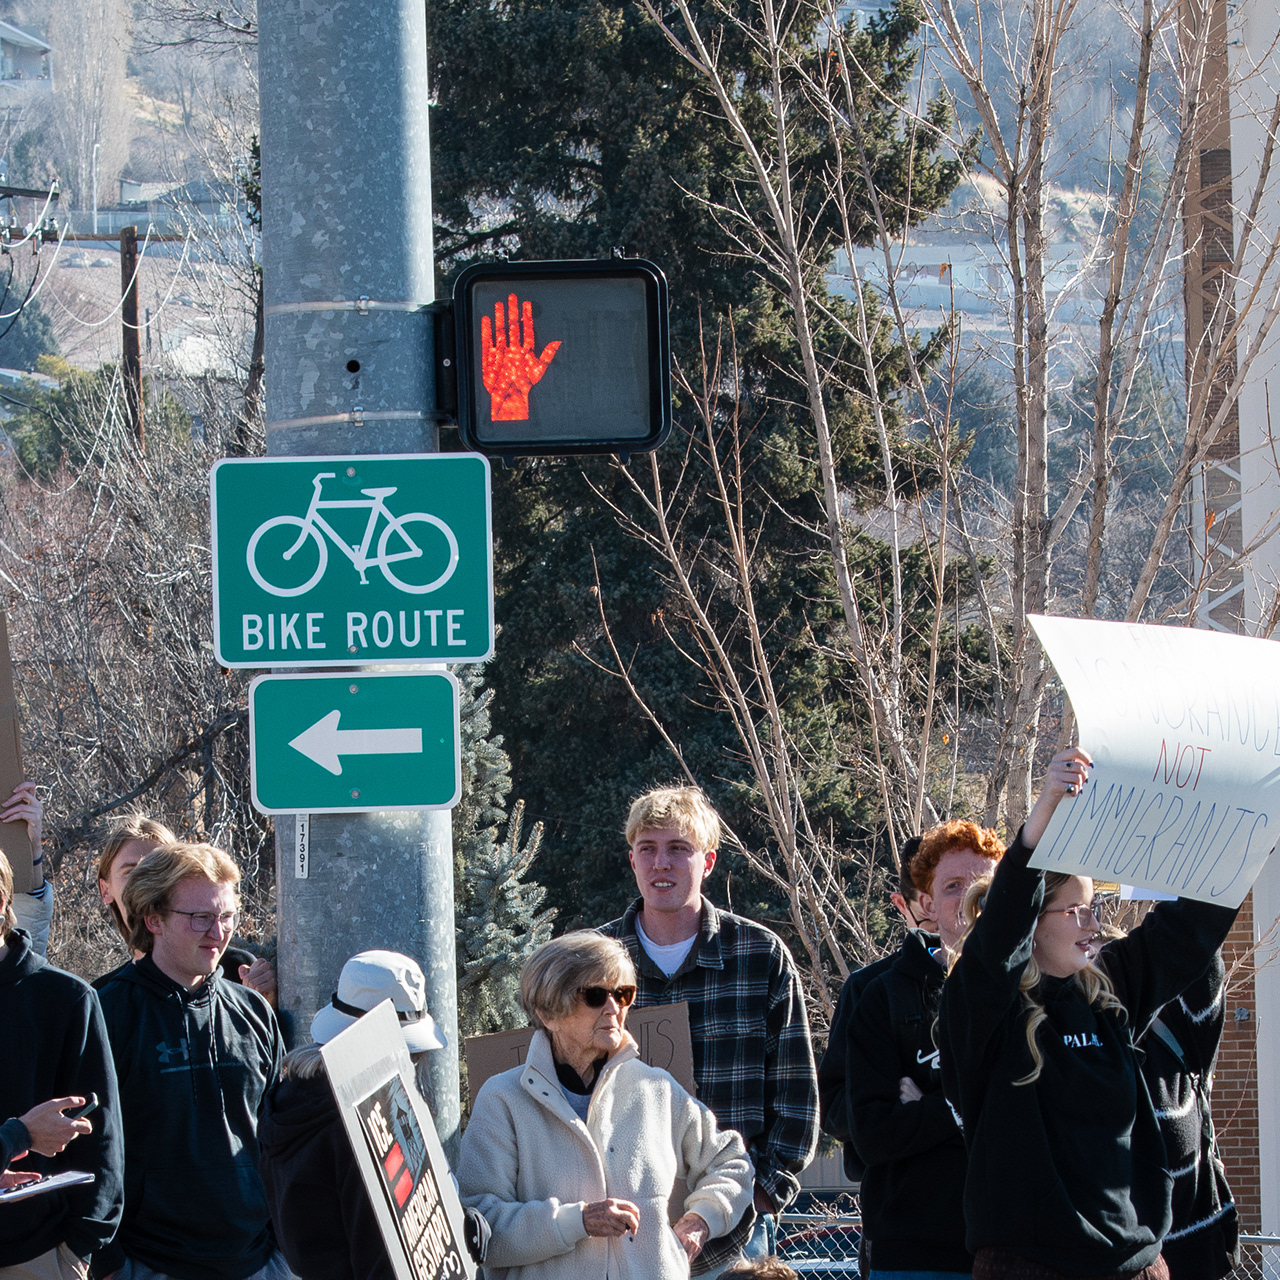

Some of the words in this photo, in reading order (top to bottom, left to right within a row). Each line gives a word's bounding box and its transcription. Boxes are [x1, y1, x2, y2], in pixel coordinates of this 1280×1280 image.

[242, 613, 326, 650] BIKE
[346, 609, 467, 648] ROUTE
[1153, 738, 1211, 791] NOT
[1048, 780, 1268, 897] IMMIGRANTS
[367, 1101, 394, 1158] ICE
[402, 1168, 438, 1252] AMERICAN
